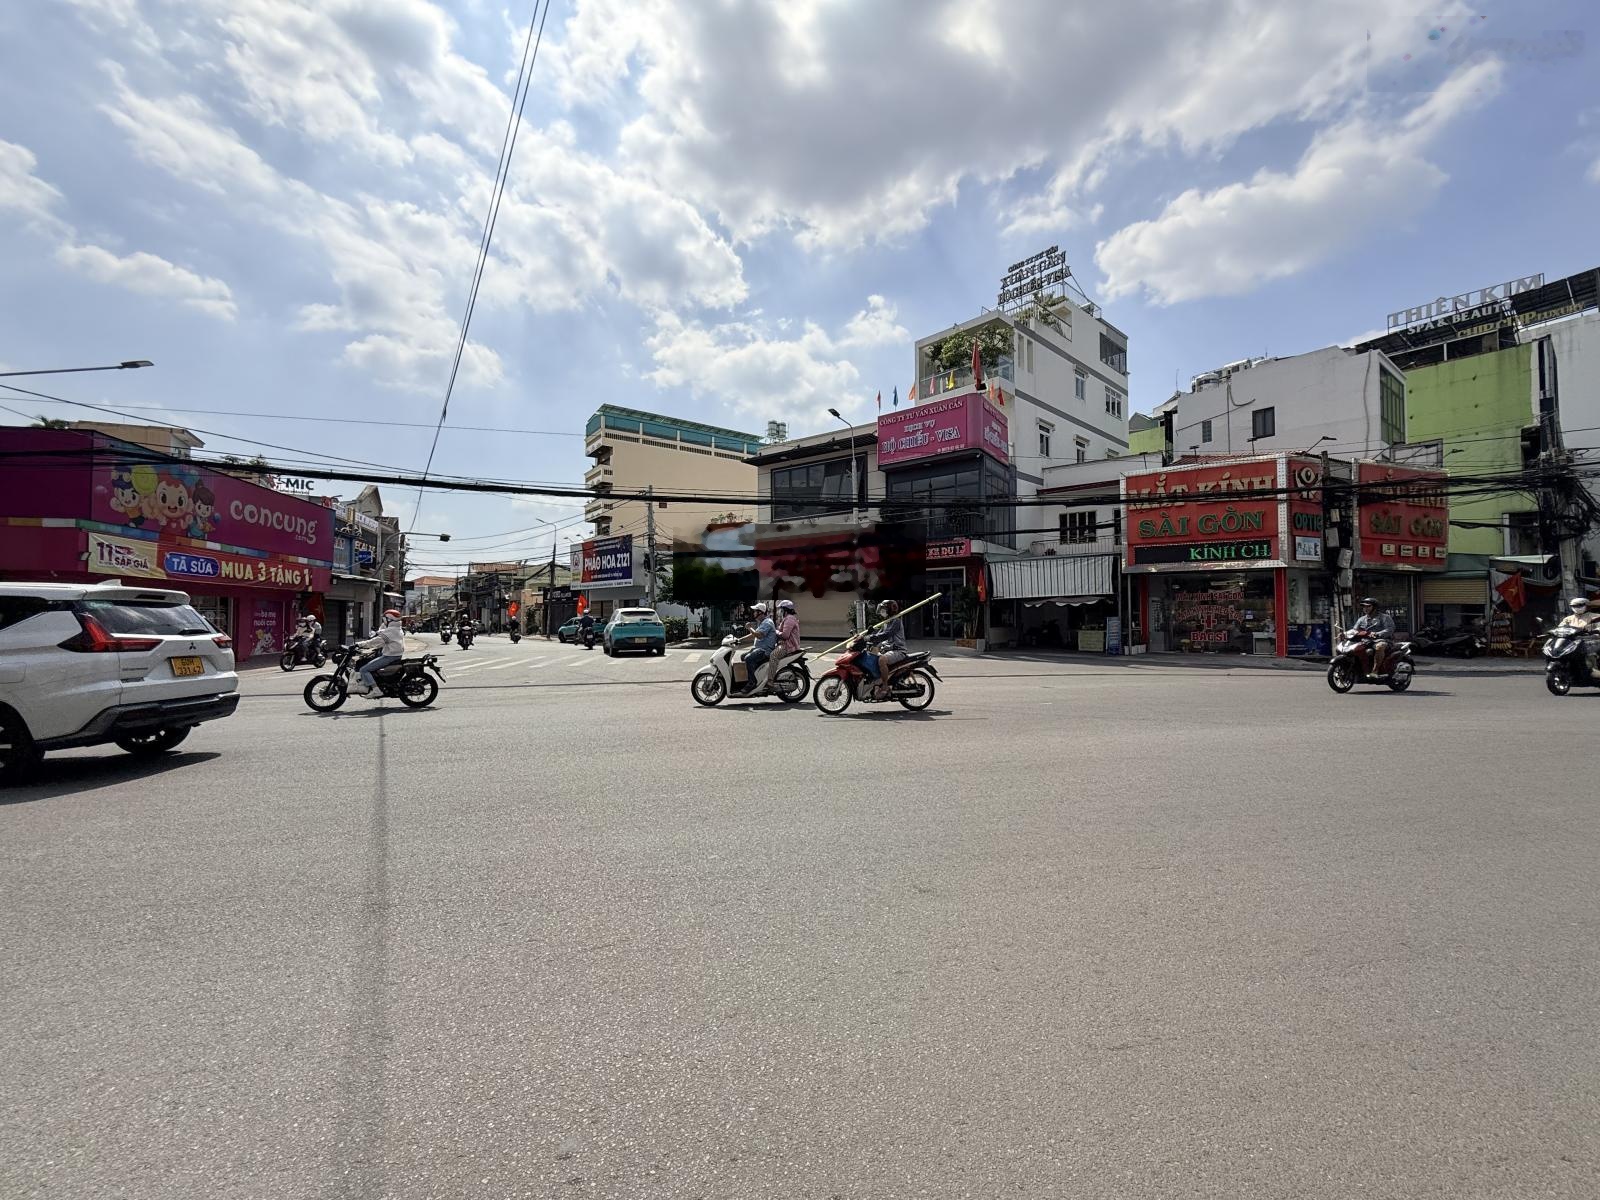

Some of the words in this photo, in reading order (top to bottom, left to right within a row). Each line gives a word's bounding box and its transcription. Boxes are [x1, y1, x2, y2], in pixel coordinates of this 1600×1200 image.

[1388, 294, 1470, 327] THIÊN
[1480, 274, 1541, 302] KIM
[1407, 321, 1435, 335] SPA
[1437, 319, 1448, 328] &
[1452, 300, 1512, 323] BEAUTY
[881, 437, 897, 454] HỘ
[898, 430, 930, 450] CHIẾU
[935, 426, 961, 442] VISA
[285, 478, 315, 491] MIC
[230, 500, 318, 545] concung
[1139, 511, 1189, 539] SÀI
[1198, 505, 1265, 534] GÒN
[133, 556, 149, 569] GIÁ
[221, 560, 254, 580] MUA
[257, 561, 266, 581] 3
[270, 564, 301, 586] TẶNG
[584, 553, 601, 571] PHÁO
[601, 554, 616, 570] HOA
[616, 552, 630, 567] Z121
